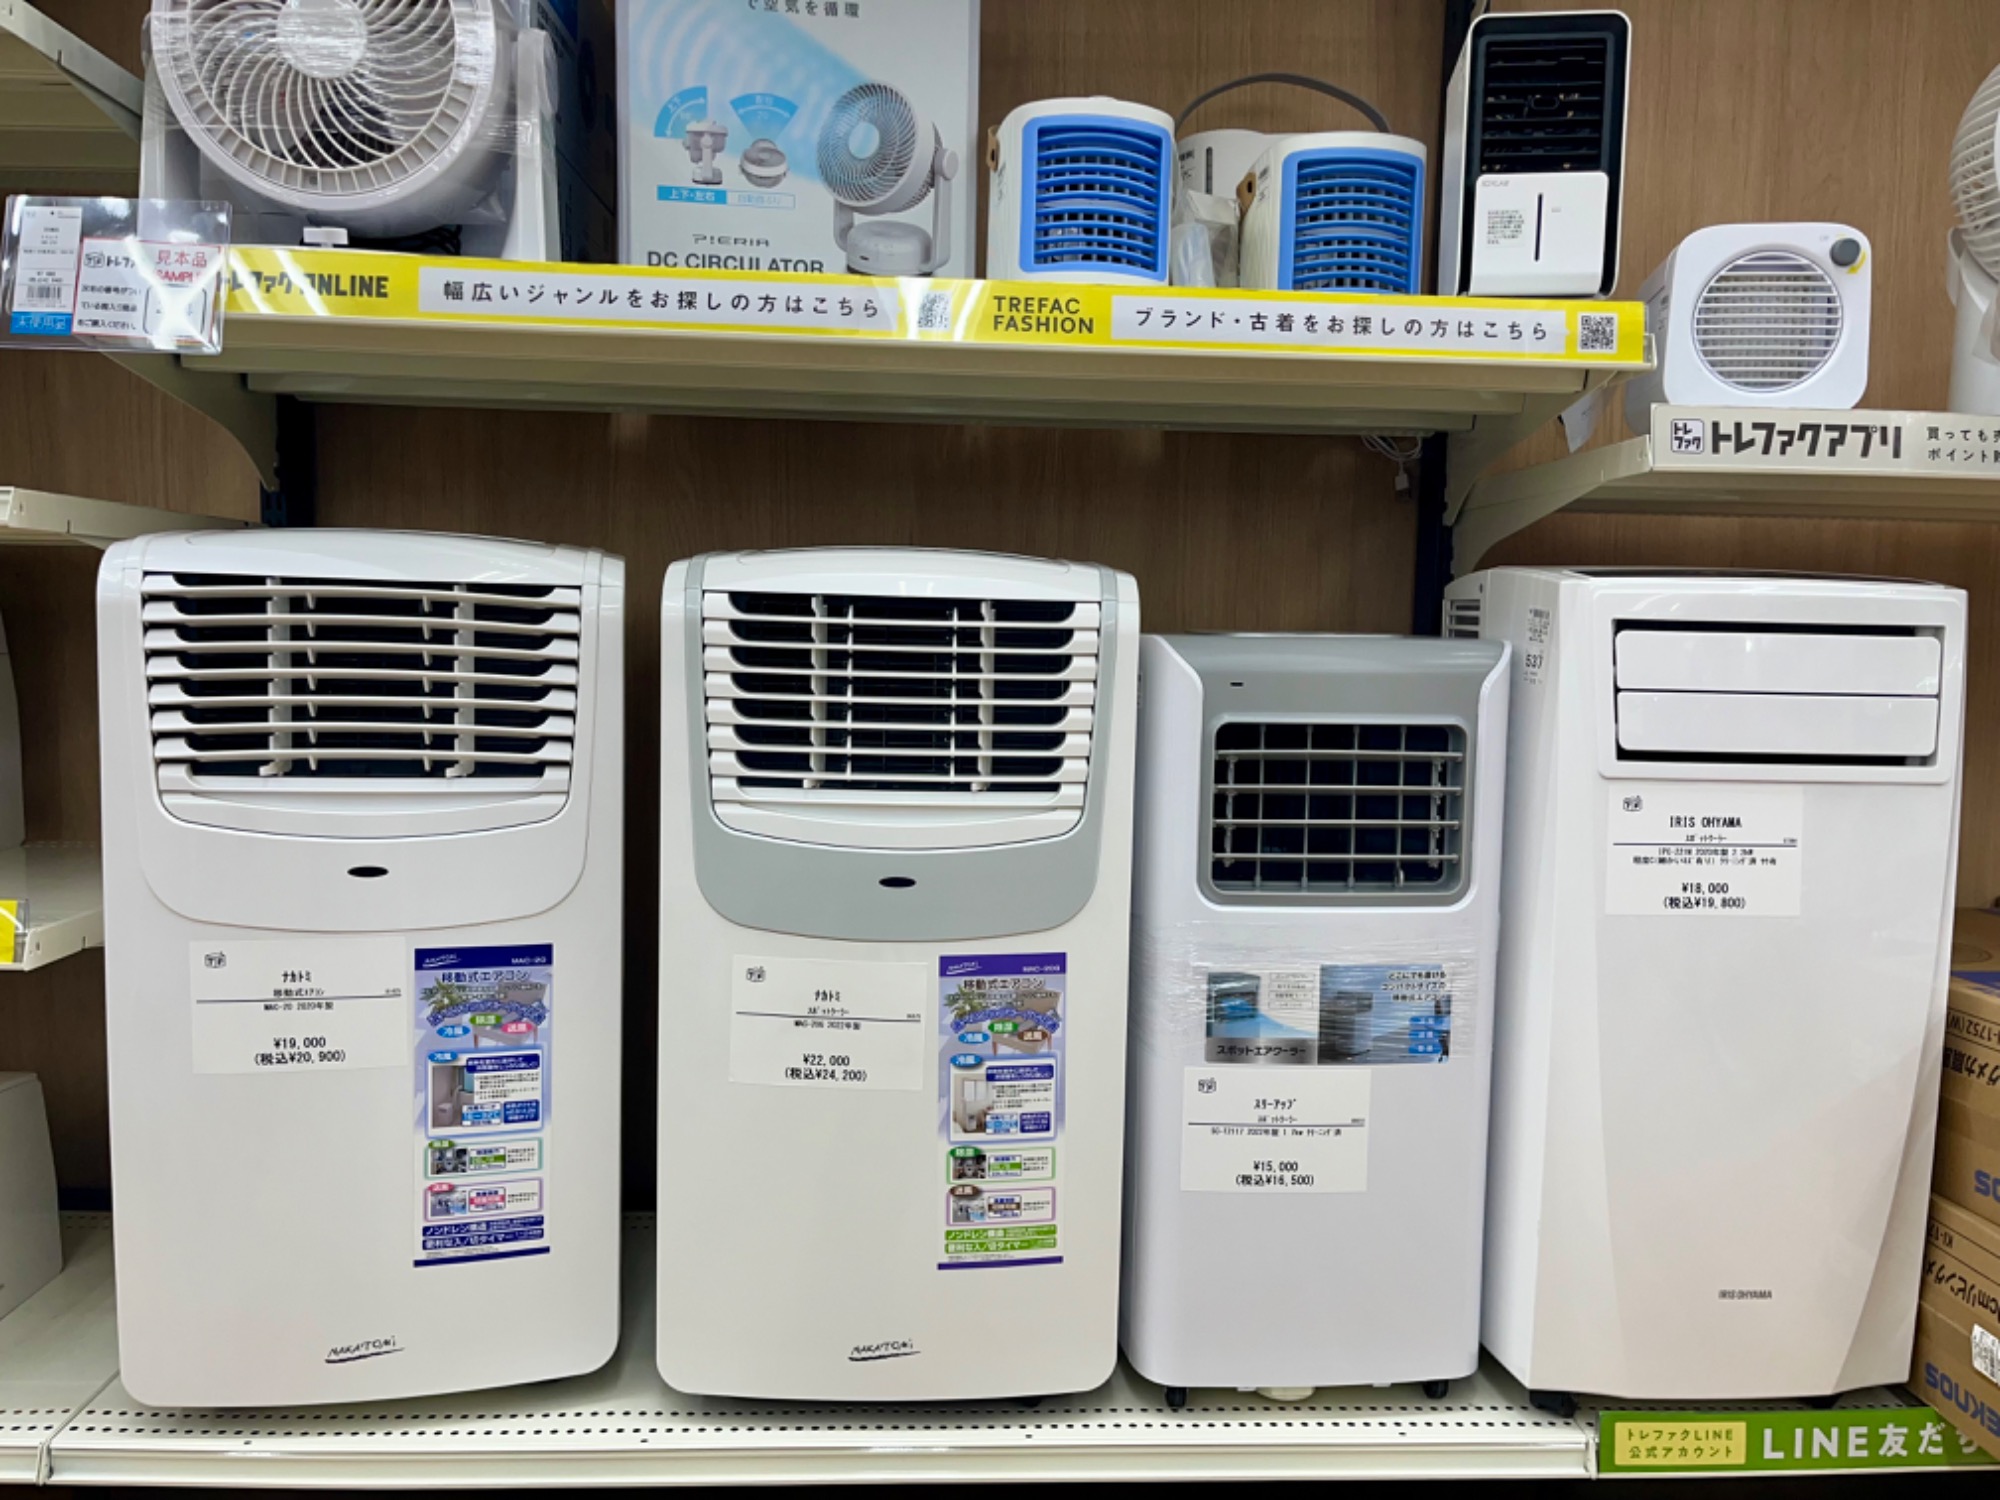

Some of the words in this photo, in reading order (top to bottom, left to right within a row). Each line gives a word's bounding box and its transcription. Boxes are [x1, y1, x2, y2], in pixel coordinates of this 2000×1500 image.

[156, 249, 207, 268] 見本品
[647, 251, 678, 268] DC
[685, 253, 824, 273] CIRCULATOR
[443, 281, 879, 319] 幅広いジャンルをお探しの方はこちら
[993, 295, 1080, 315] TREFAC
[993, 315, 1094, 334] FASHION
[1135, 308, 1549, 342] ブランド・古着をお探しの方はこちら
[1711, 420, 1901, 460] トレファクアプリ
[1670, 816, 1695, 828] IRIS
[1701, 817, 1742, 828] OHYAMA
[1682, 882, 1729, 894] ¥18,000
[1664, 897, 1746, 909] (税込¥19,800)
[273, 1036, 326, 1050] ¥19,000
[254, 1050, 346, 1066] (税込¥20,900)
[803, 1054, 850, 1067] ¥22,000
[785, 1066, 868, 1082] (税込¥24,200)
[1253, 1160, 1299, 1173] ¥15,000
[1235, 1174, 1315, 1187] (税込¥16,500)
[1627, 1428, 1734, 1442] トレファクLINE
[1628, 1445, 1733, 1460] 公式アカウント
